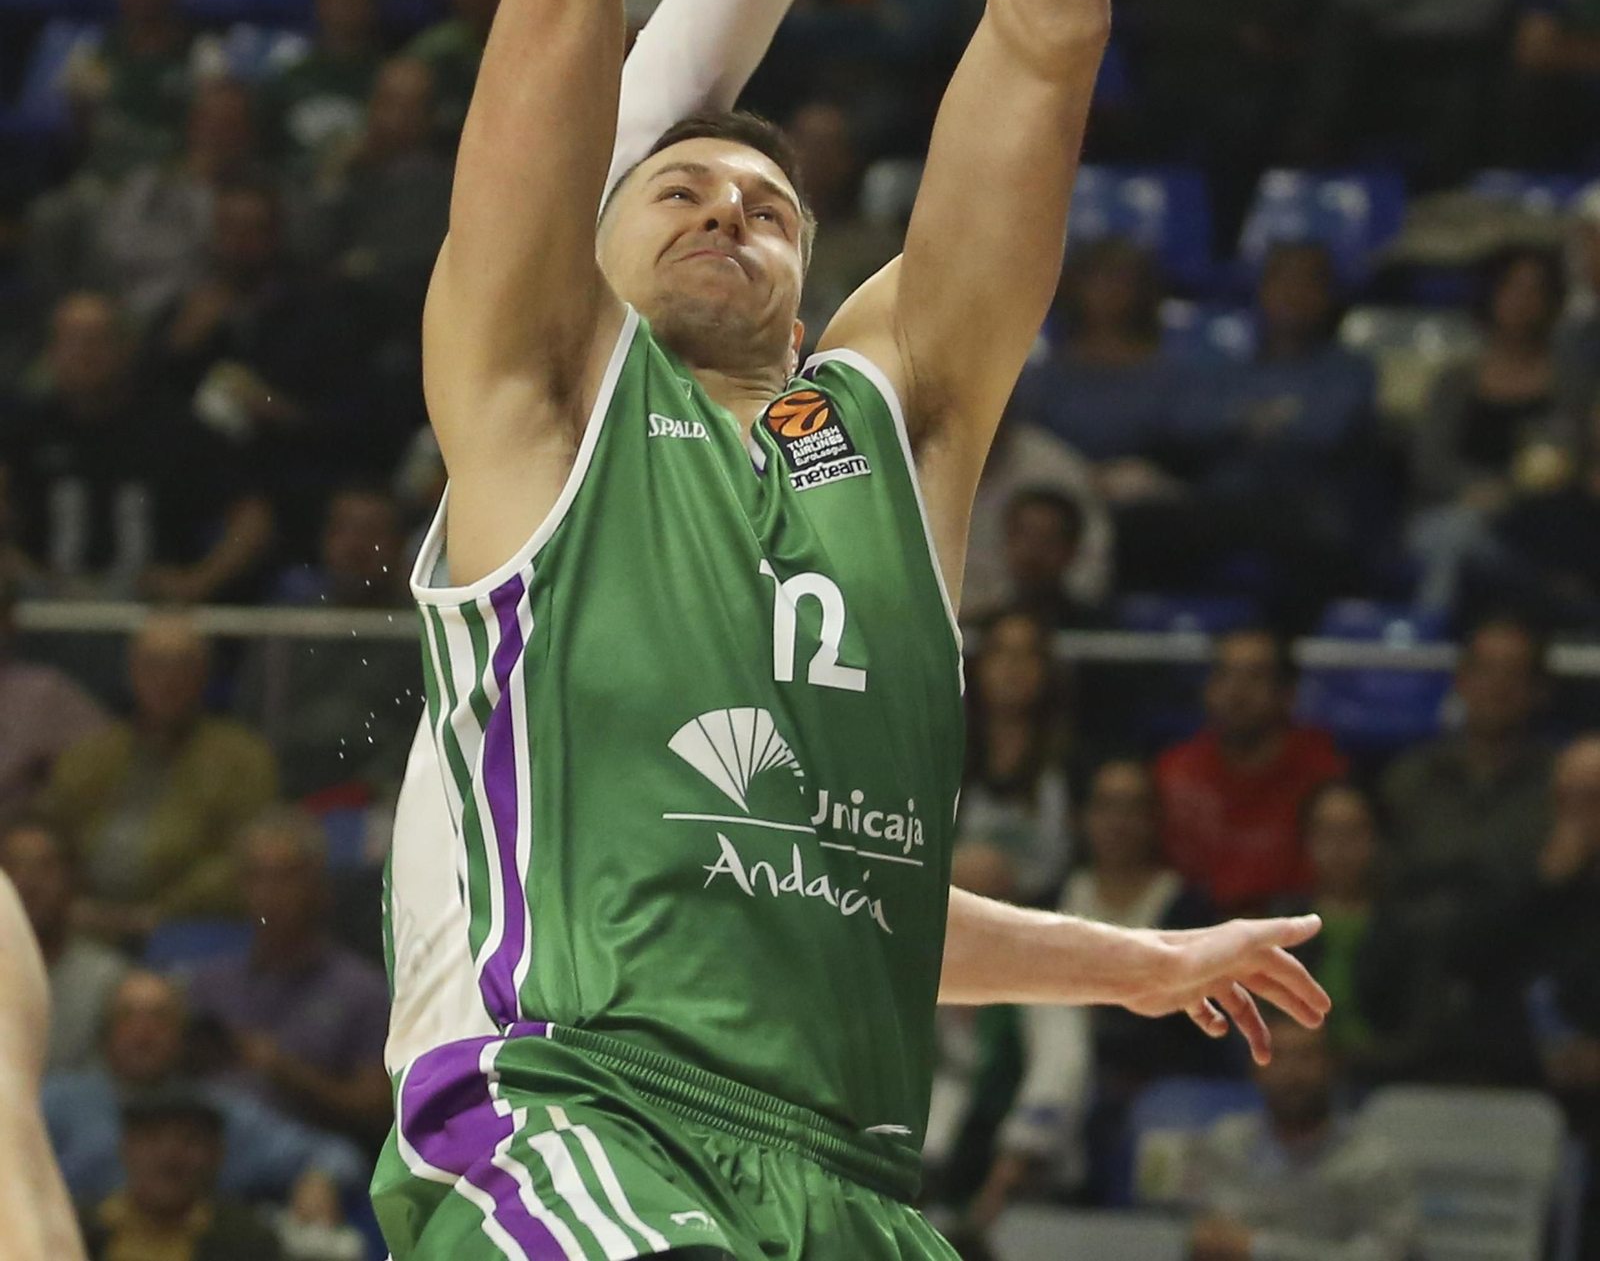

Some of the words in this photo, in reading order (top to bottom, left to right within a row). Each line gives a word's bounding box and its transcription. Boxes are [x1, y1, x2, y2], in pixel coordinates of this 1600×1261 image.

[647, 413, 711, 442] SPALD
[786, 424, 840, 451] TURKISH
[792, 433, 844, 459] AIRLINES
[759, 558, 867, 692] 12
